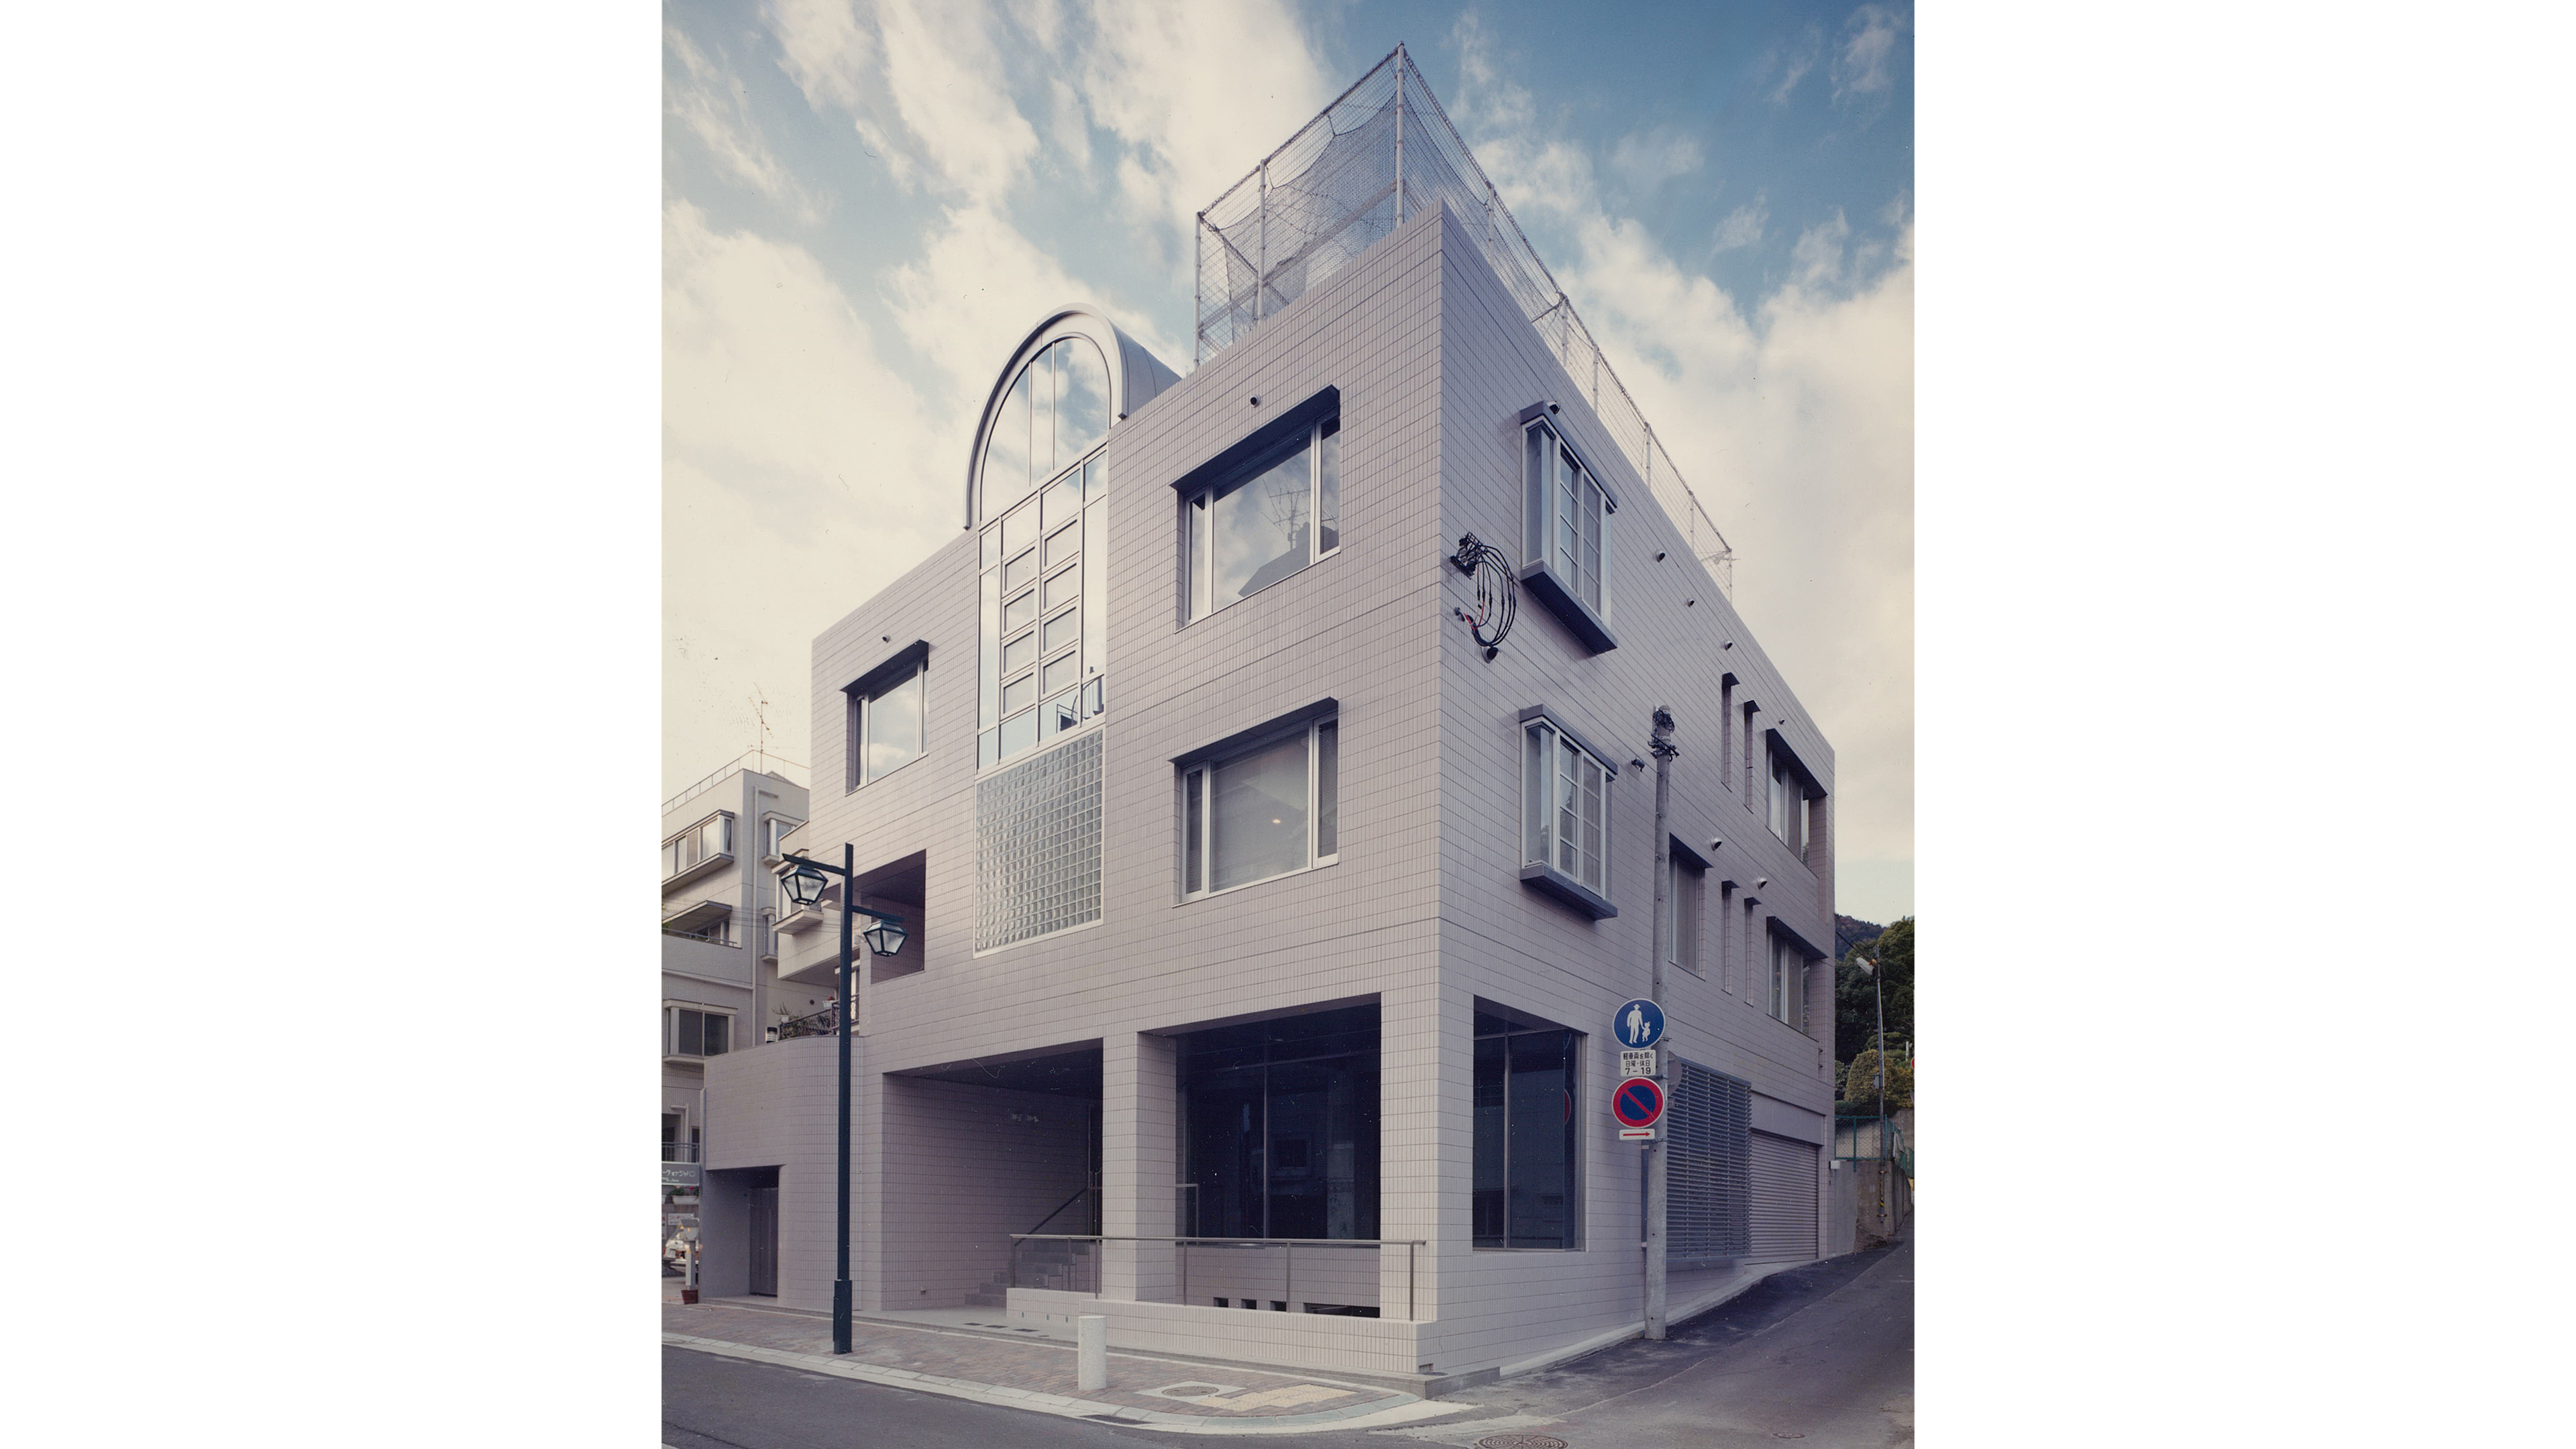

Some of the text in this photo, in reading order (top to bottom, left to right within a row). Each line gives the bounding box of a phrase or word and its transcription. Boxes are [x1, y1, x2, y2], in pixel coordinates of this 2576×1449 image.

[1623, 1052, 1653, 1060] 軽車両を除く
